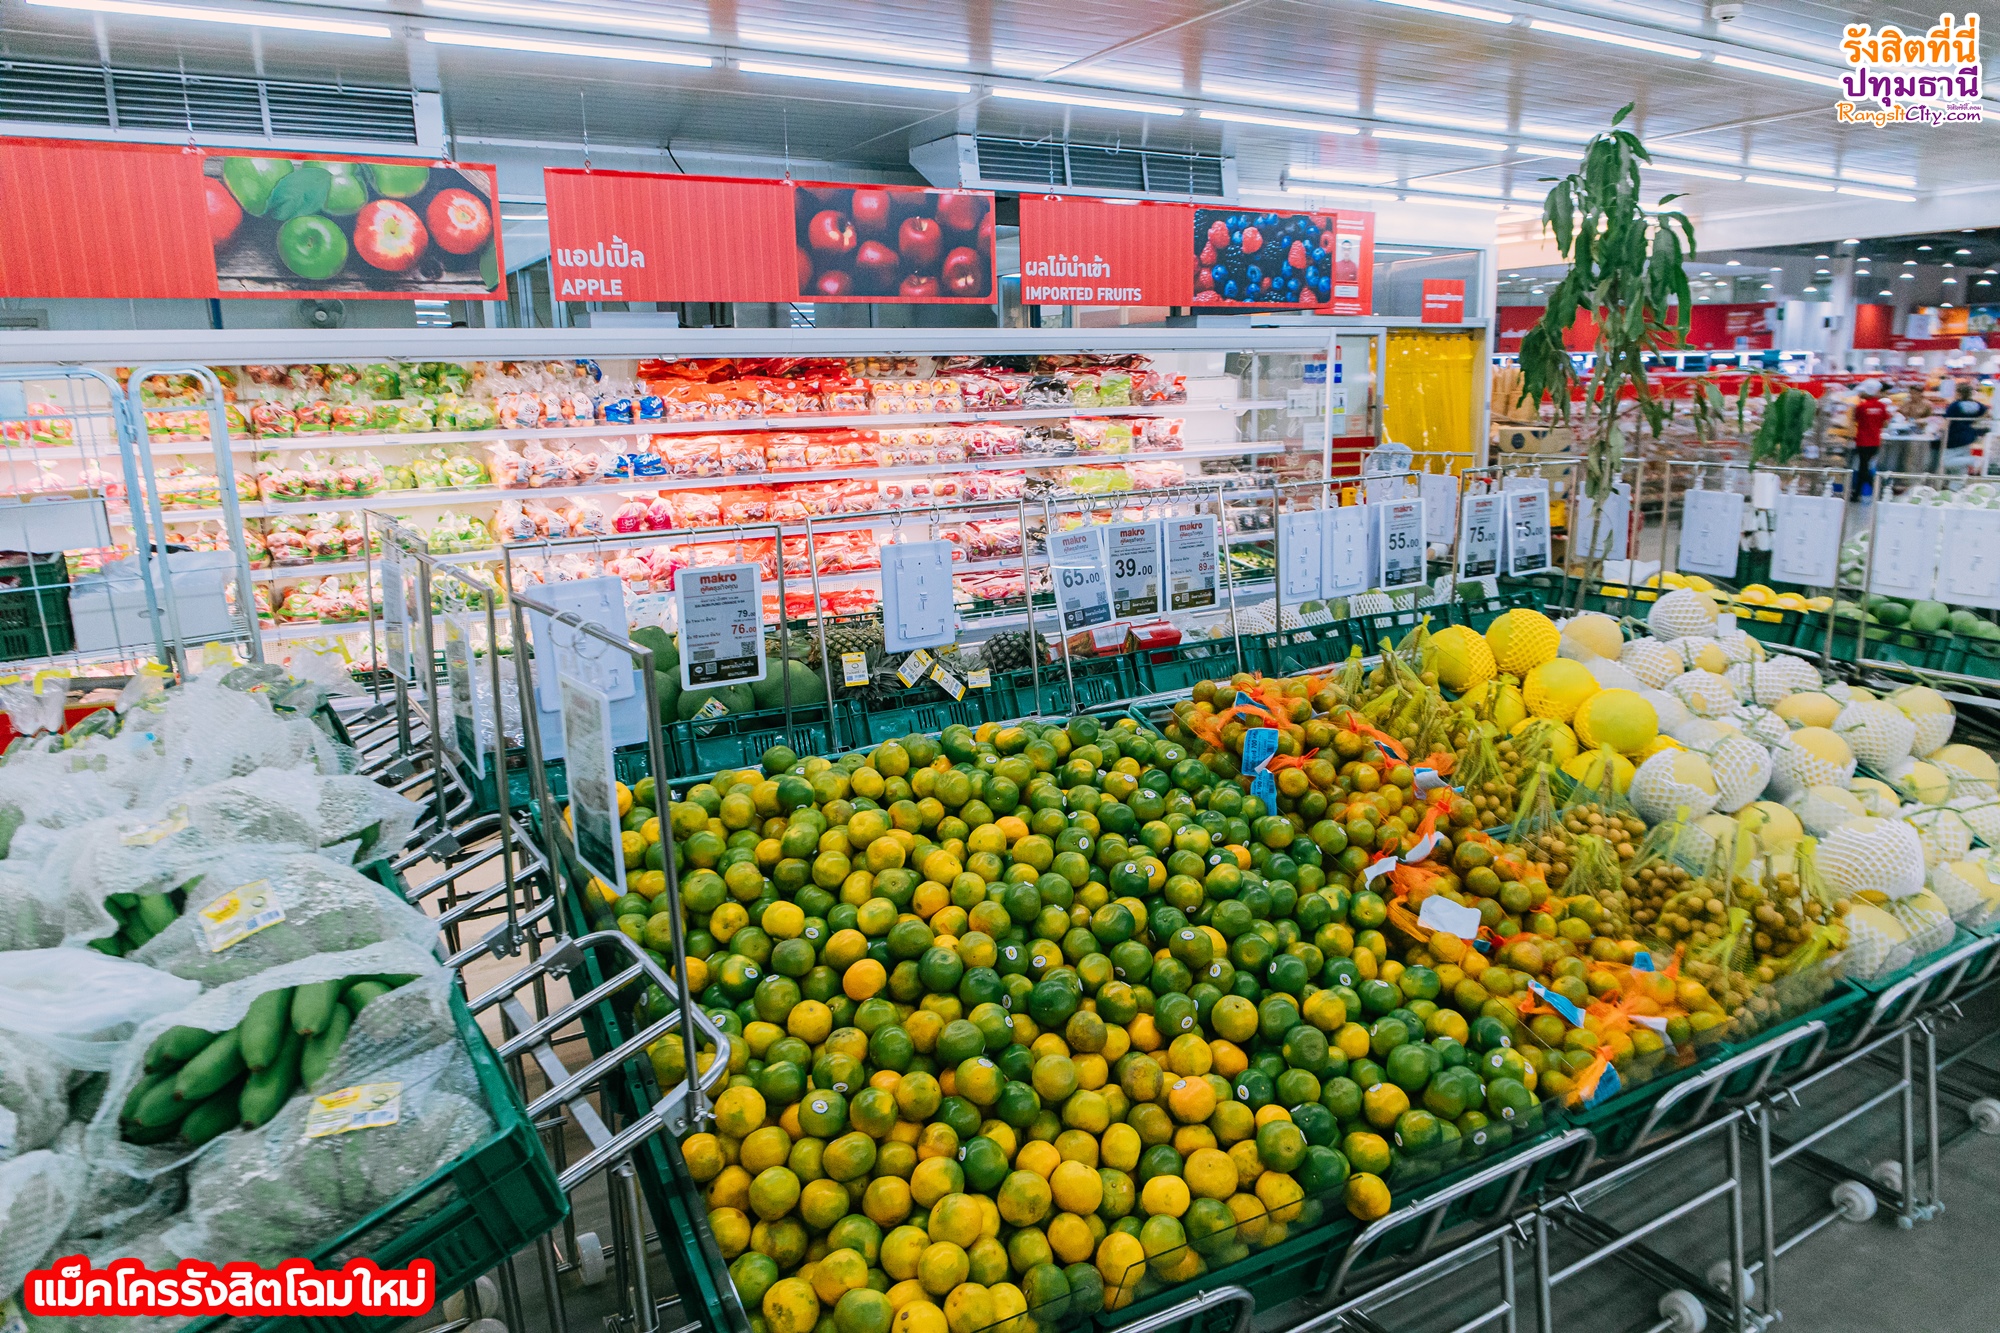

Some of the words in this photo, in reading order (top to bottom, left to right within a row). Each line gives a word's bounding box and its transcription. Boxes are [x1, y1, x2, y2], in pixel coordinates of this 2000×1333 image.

[557, 234, 645, 268] แอปเปิ้ล
[1025, 253, 1111, 278] ผลไม้นำเข้า
[561, 278, 623, 296] APPLE
[1025, 286, 1093, 301] IMPORTED
[1097, 287, 1142, 302] FRUITS
[1120, 528, 1145, 537] makro
[1179, 522, 1203, 531] makro
[1469, 526, 1496, 543] 75.00
[1062, 535, 1087, 546] makro
[1388, 532, 1420, 550] 55.00
[1115, 558, 1153, 578] 39.00
[700, 572, 737, 585] makro
[1062, 568, 1100, 588] 65.00
[737, 609, 756, 618] 79.00
[731, 623, 757, 635] 76.00
